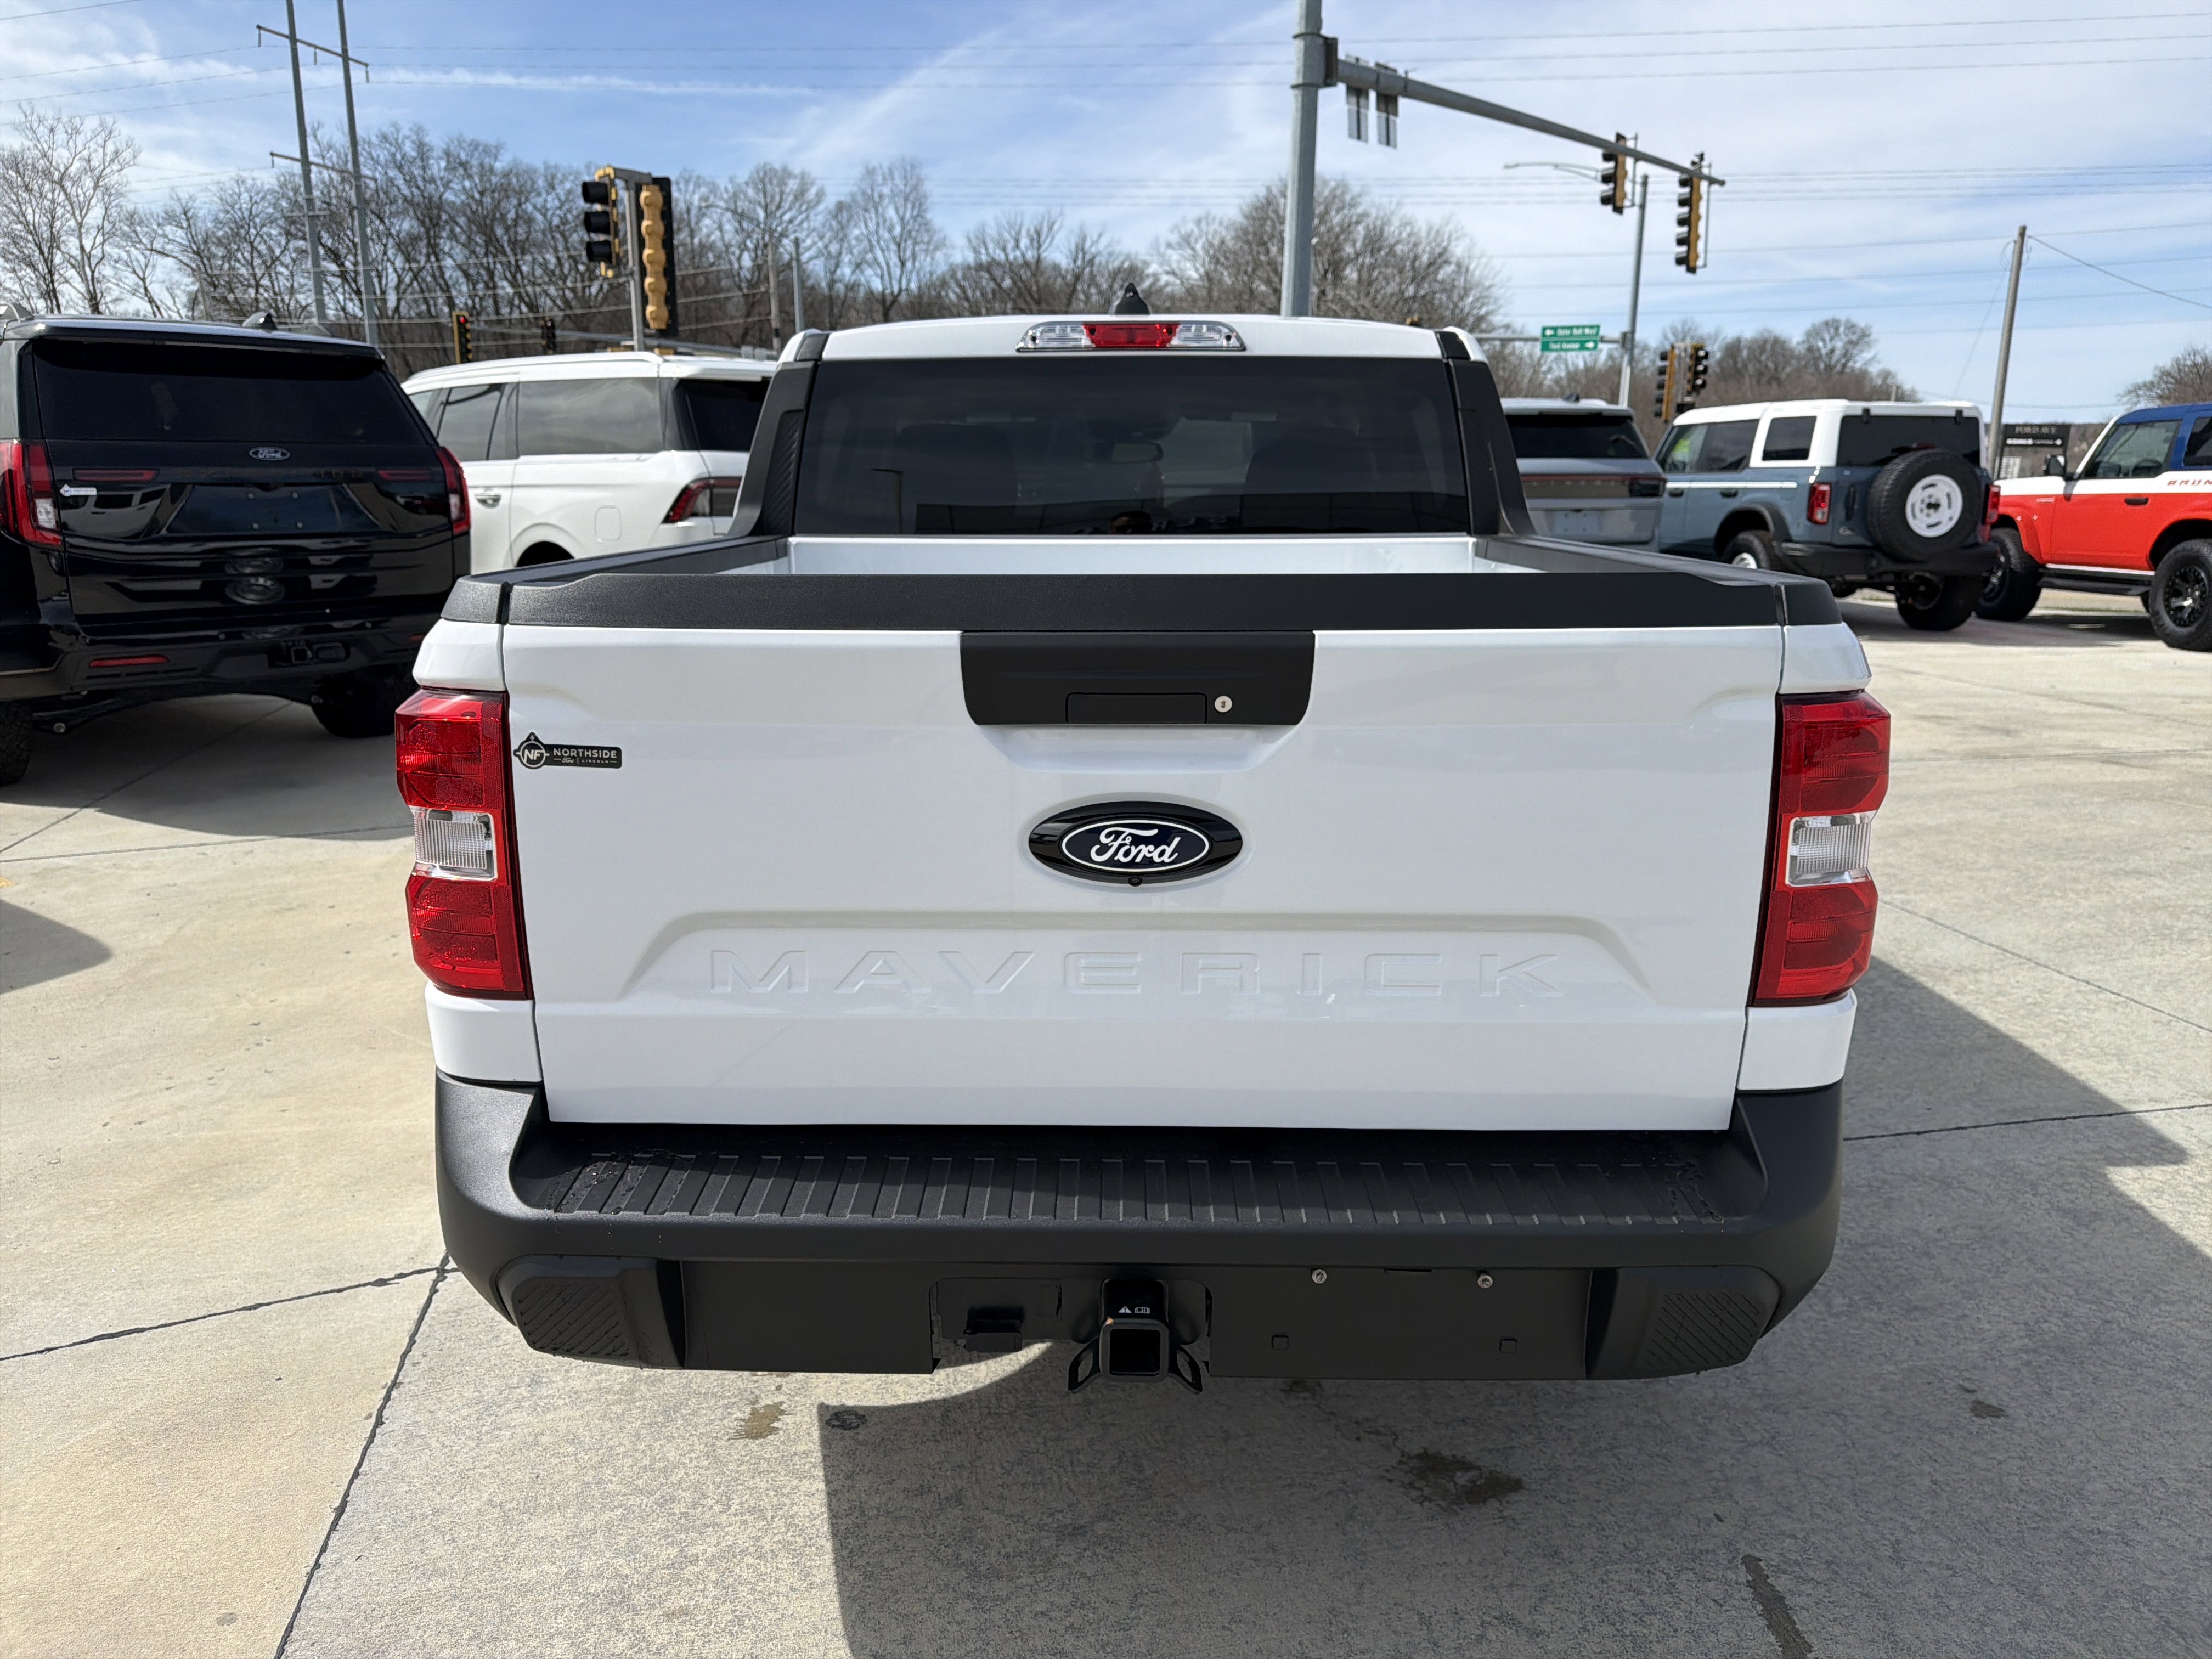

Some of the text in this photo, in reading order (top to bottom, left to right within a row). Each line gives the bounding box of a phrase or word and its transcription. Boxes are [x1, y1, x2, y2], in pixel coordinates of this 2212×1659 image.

[524, 749, 544, 763] NF
[553, 748, 617, 759] NORTHSIDE
[1090, 827, 1181, 863] Ford
[710, 950, 1565, 997] MAVERICK
